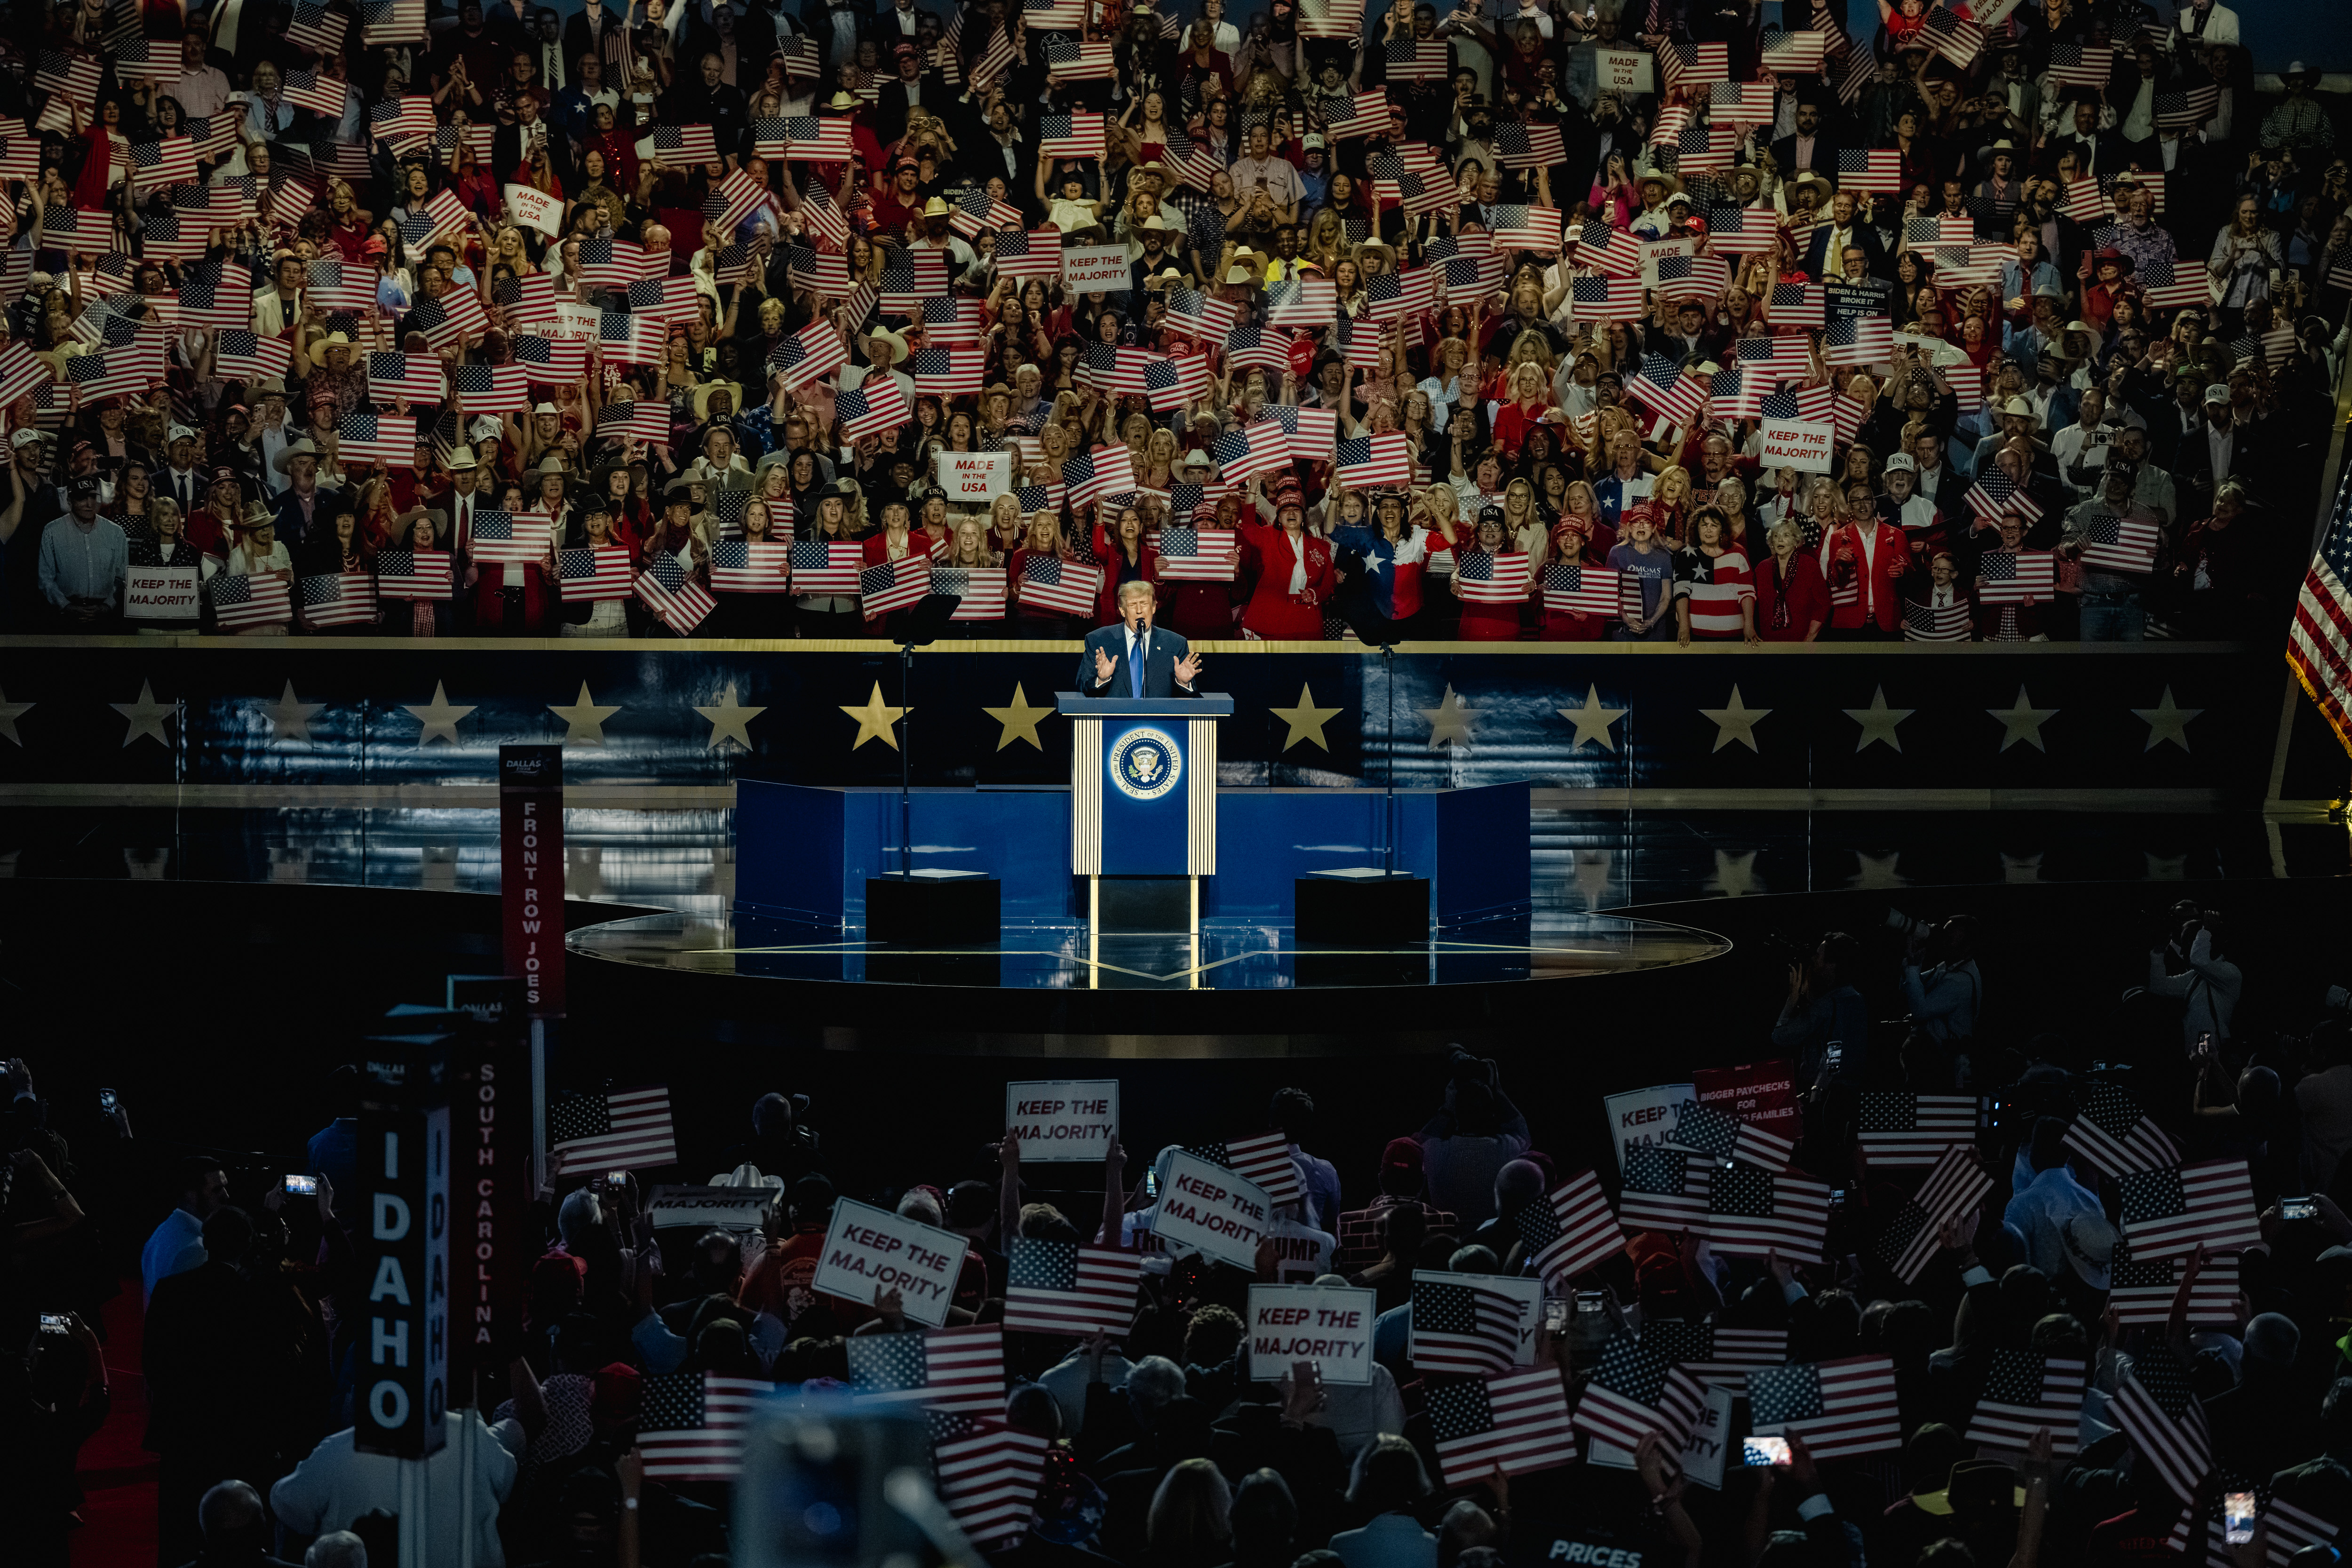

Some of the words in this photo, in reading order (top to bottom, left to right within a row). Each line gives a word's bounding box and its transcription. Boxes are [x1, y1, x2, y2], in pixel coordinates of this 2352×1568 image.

[1973, 0, 1988, 12] KE
[1979, 0, 2005, 24] MAJO
[1609, 57, 1638, 66] MADE
[1613, 76, 1633, 85] USA
[516, 191, 550, 208] MADE
[519, 210, 540, 222] USA
[1650, 247, 1680, 258] MADE
[1070, 256, 1098, 267] KEEP
[1101, 255, 1122, 264] THE
[1068, 269, 1126, 281] MAJORITY
[25, 294, 41, 305] BIDE
[1859, 290, 1885, 298] HARRIS
[577, 318, 596, 326] THE
[2209, 388, 2223, 397] USA
[716, 415, 731, 423] USA
[415, 435, 430, 444] USA
[1768, 430, 1798, 441] KEEP
[1803, 434, 1826, 444] THE
[1764, 446, 1828, 460] MAJORITY
[955, 460, 994, 470] MADE
[2116, 462, 2131, 474] USA
[78, 480, 95, 489] USA
[961, 483, 987, 493] USA
[929, 488, 944, 497] USA
[132, 580, 164, 589] KEEP
[169, 580, 191, 589] THE
[129, 595, 196, 605] MAJORITY
[1113, 732, 1145, 762] PRESIDENT
[1165, 740, 1178, 770] UNITED
[506, 759, 541, 768] DALLAS
[1122, 781, 1139, 796] SEAL
[1152, 774, 1176, 796] STATES
[523, 802, 538, 880] FRONT
[522, 888, 541, 934] ROW
[525, 941, 540, 1004] JOES
[1700, 1088, 1734, 1102] BIGGER
[1736, 1081, 1790, 1097] PAYCHECKS
[1016, 1100, 1065, 1115] KEEP
[1071, 1099, 1108, 1114] THE
[1737, 1099, 1756, 1109] FOR
[478, 1063, 496, 1166] SOUTH
[1622, 1106, 1667, 1128] KEEP
[1750, 1107, 1794, 1122] FAMILIES
[1014, 1125, 1113, 1140] MAJORITY
[653, 1199, 767, 1209] MAJORITY
[1176, 1173, 1227, 1202] KEEP
[1232, 1194, 1263, 1221] THE
[1164, 1199, 1265, 1247] MAJORITY
[842, 1224, 902, 1251] KEEP
[908, 1243, 951, 1272] THE
[1276, 1237, 1320, 1262] UMP
[475, 1178, 494, 1345] CAROLINA
[368, 1131, 412, 1430] IDAHO
[829, 1250, 947, 1301] MAJORITY
[1258, 1308, 1310, 1326] KEEP
[1317, 1310, 1361, 1329] THE
[1254, 1337, 1365, 1359] MAJORITY
[1549, 1539, 1643, 1568] PRICES
